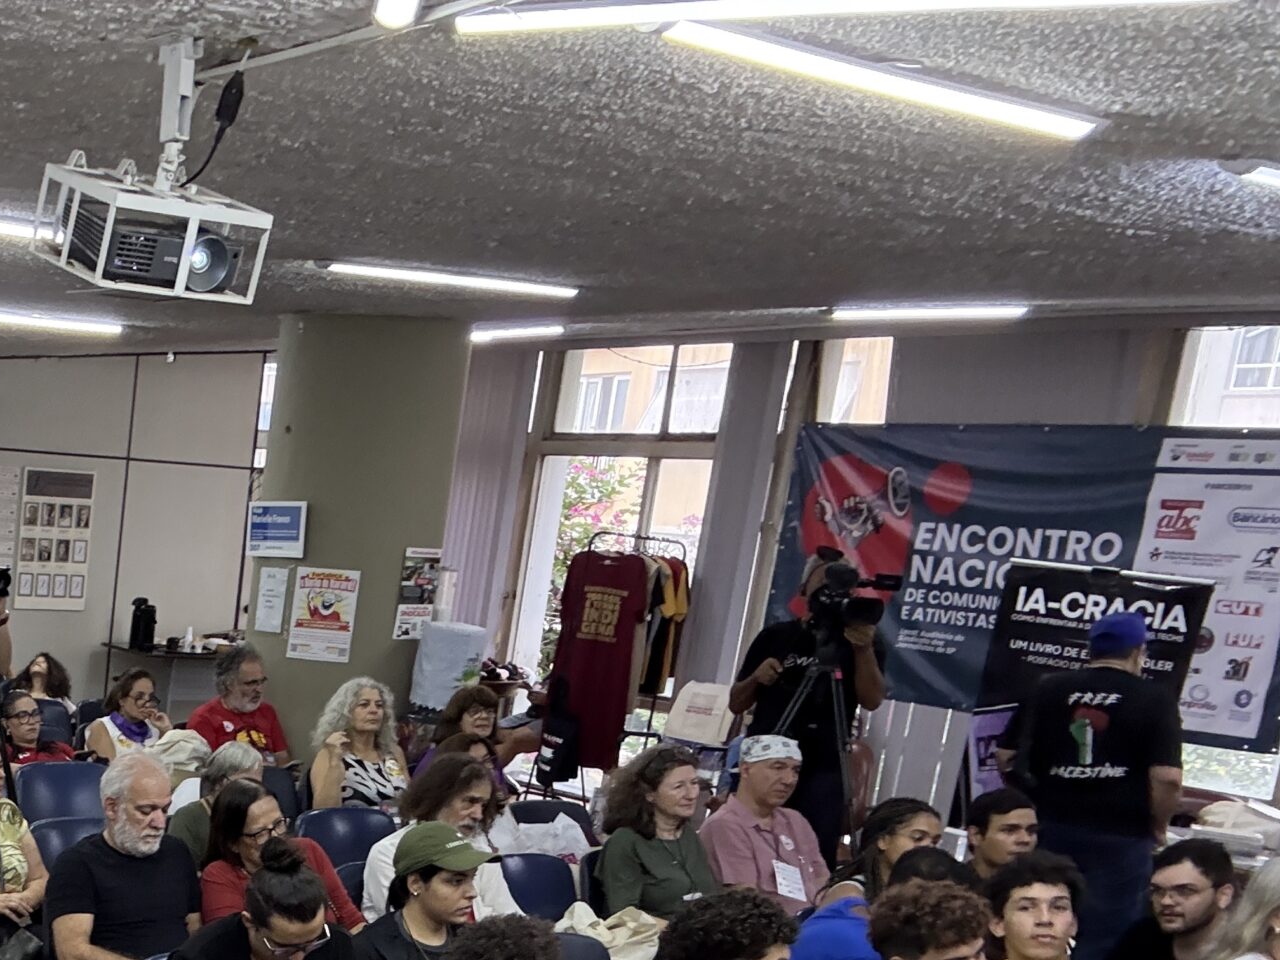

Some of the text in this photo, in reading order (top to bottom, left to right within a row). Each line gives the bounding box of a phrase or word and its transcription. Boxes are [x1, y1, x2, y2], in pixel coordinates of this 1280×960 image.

[914, 521, 1123, 564] ENCONTRO
[904, 587, 1001, 611] DE COMUNI
[901, 605, 998, 630] E ATIVISTAS
[1009, 639, 1028, 650] UM
[1029, 641, 1063, 656] LIVRO
[1063, 647, 1079, 658] DE
[1142, 657, 1174, 671] GLER
[1068, 691, 1123, 706] FREE
